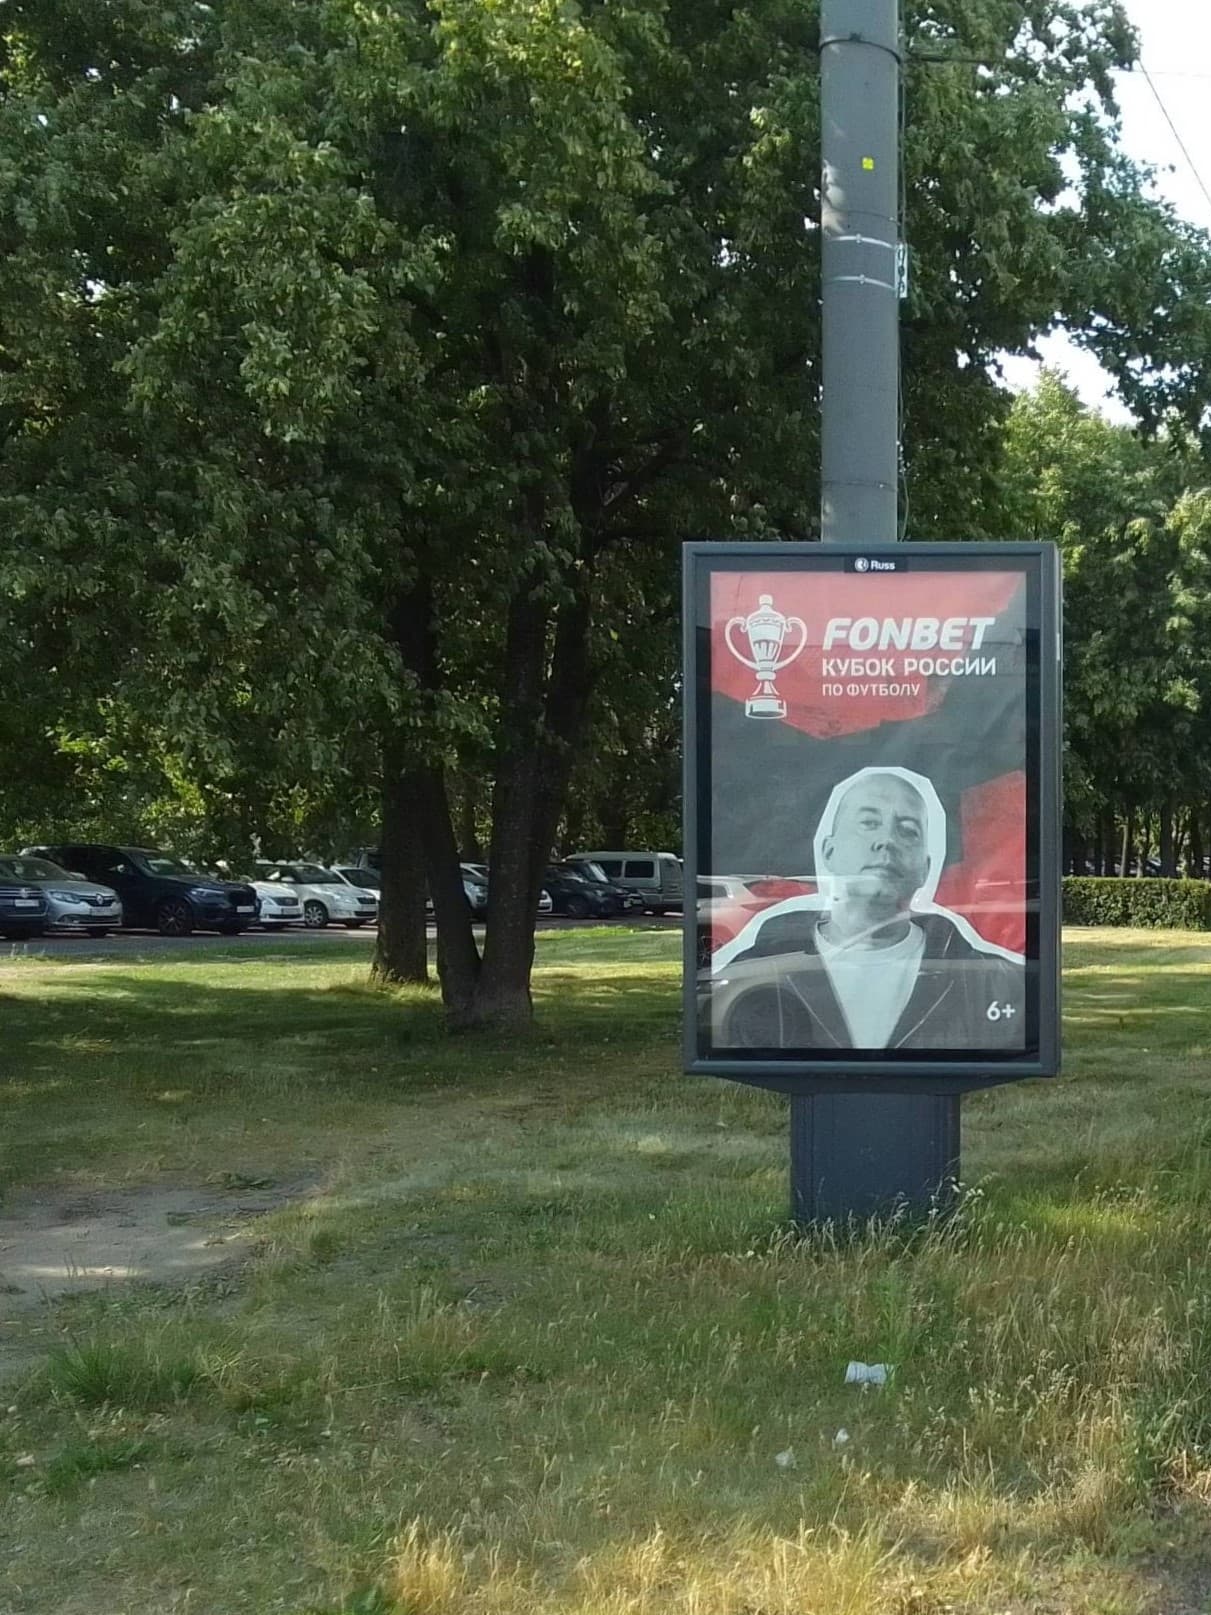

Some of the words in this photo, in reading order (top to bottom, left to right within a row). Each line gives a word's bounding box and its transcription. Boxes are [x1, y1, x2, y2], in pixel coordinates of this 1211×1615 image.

[870, 560, 896, 570] Russ
[822, 617, 996, 650] FONBET
[822, 658, 896, 676] КУБОК
[904, 657, 996, 676] РОССИИ
[822, 684, 843, 696] ПО
[847, 683, 921, 697] ФУТБОЛУ
[987, 1000, 1016, 1021] 6+
